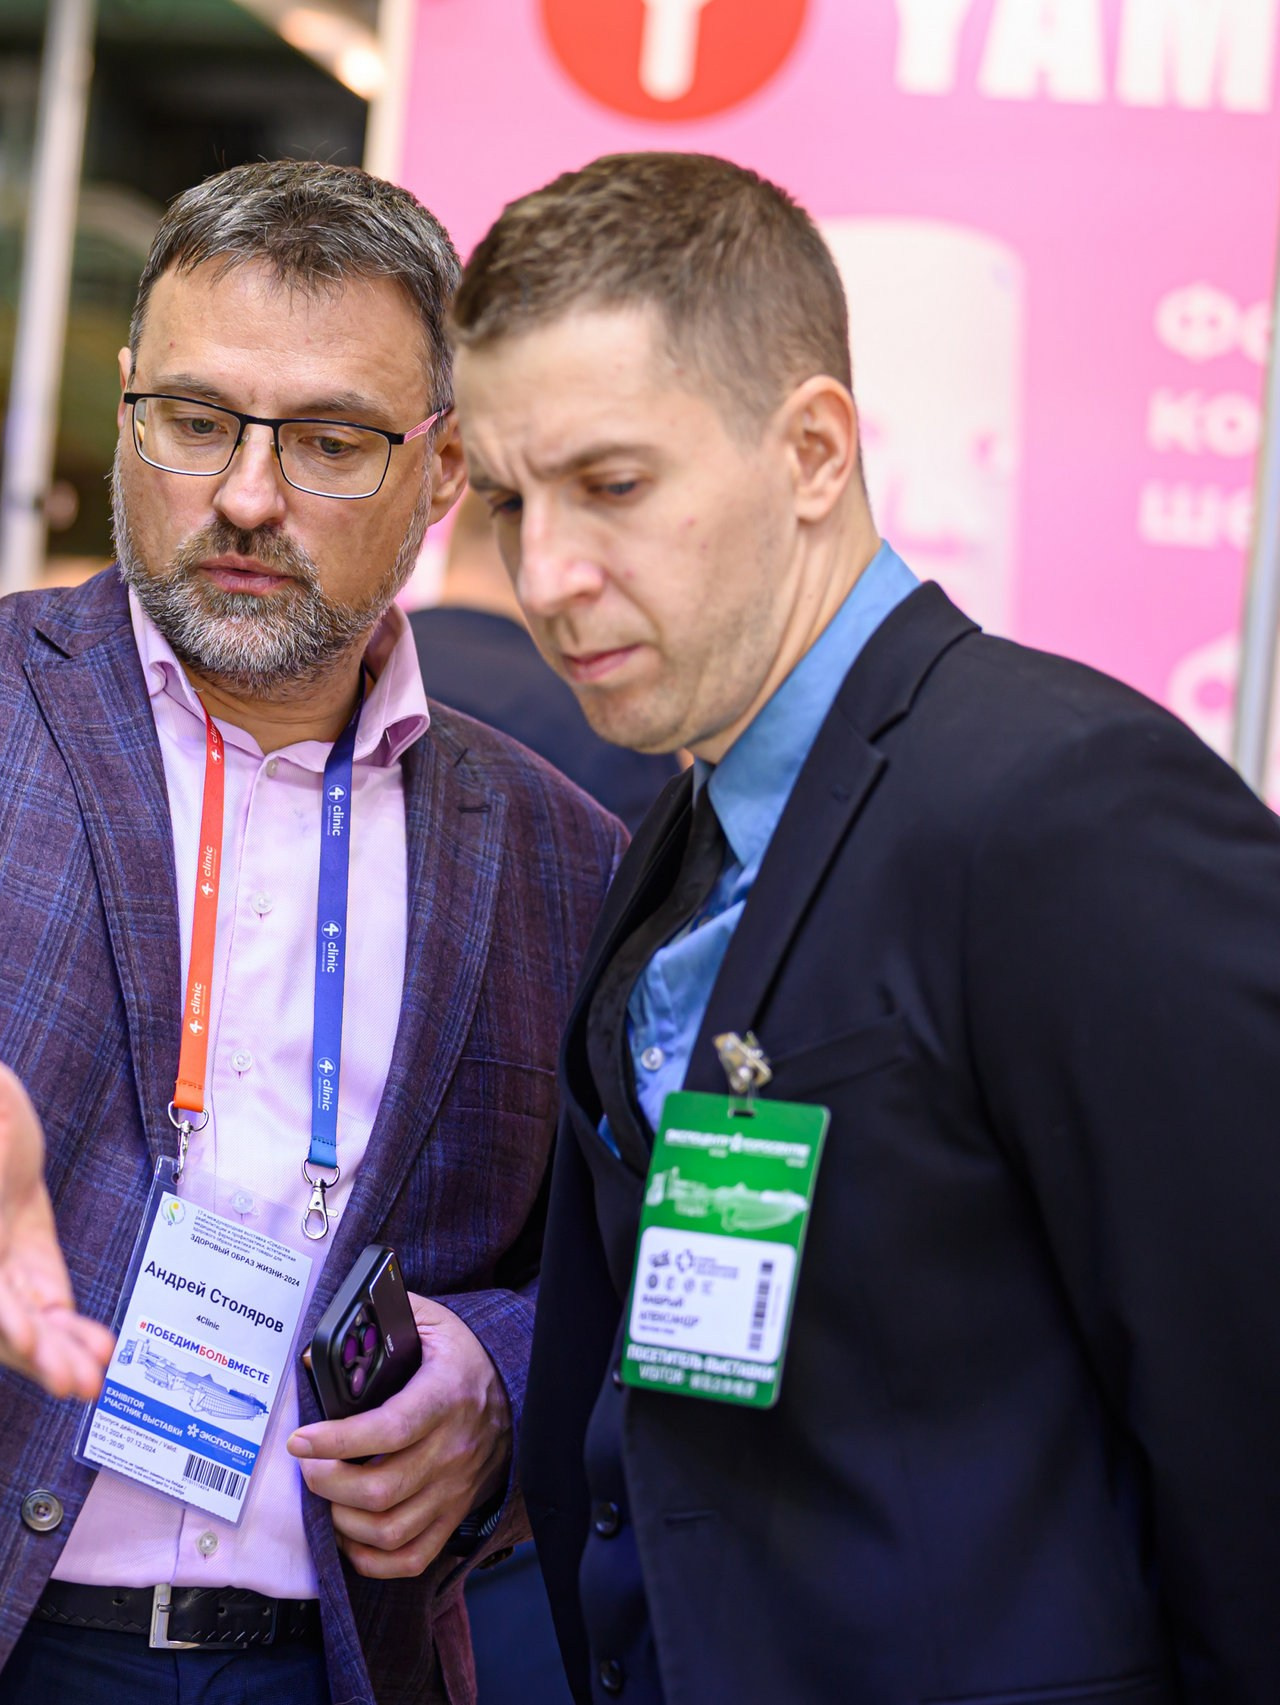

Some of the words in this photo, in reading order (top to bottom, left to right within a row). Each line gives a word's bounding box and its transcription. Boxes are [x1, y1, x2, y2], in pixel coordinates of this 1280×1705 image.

[332, 804, 345, 837] clinic
[203, 845, 214, 877] clinic
[326, 941, 339, 974] clinic
[192, 982, 202, 1015] clinic
[322, 1079, 333, 1111] clinic
[190, 1233, 230, 1256] ЗДОРОВЫЙ
[230, 1251, 255, 1266] ОБРАЗ
[255, 1262, 300, 1286] ЖИЗНИ-2024
[144, 1260, 206, 1297] Андрей
[209, 1288, 283, 1333] Столяров
[195, 1314, 219, 1330] 4Clinic
[139, 1321, 270, 1384] #ПОБЕДИМБОЛЬВМЕСТЕ
[105, 1386, 144, 1409] EXHIBITOR
[103, 1395, 141, 1418] УЧАСТНИК
[141, 1413, 183, 1436] ВЫСТАВКИ
[199, 1430, 255, 1459] ЭКСПОЦЕНТР
